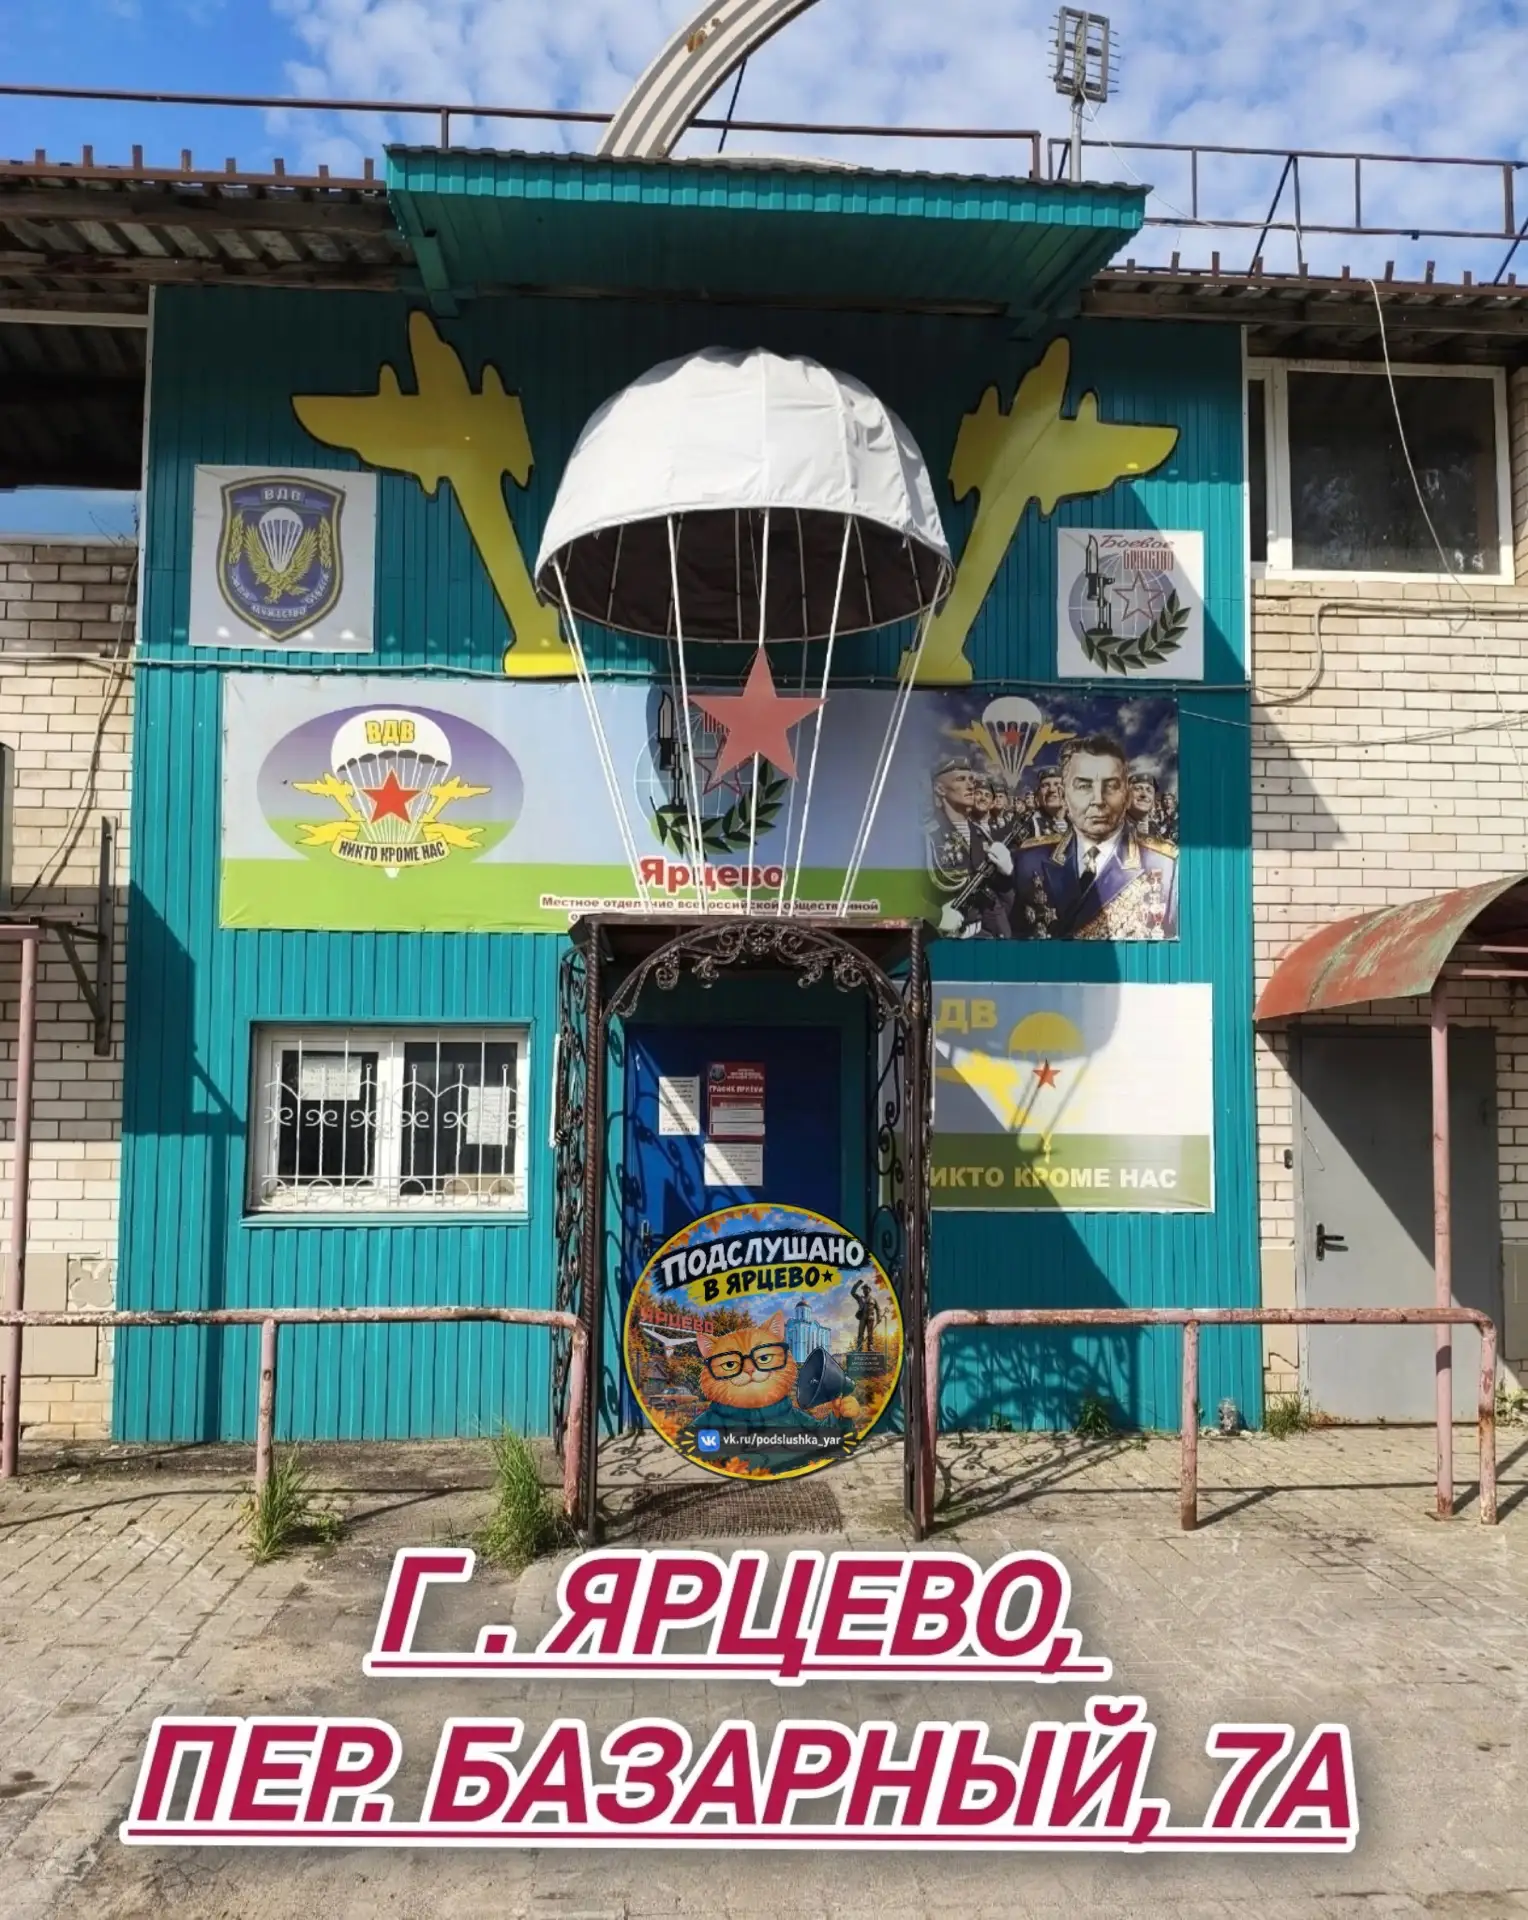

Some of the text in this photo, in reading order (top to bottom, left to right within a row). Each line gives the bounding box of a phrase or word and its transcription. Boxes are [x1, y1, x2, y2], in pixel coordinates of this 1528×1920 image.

[264, 488, 301, 501] ВДВ
[365, 720, 415, 746] ВДВ
[339, 840, 446, 862] НИКТО КРОМЕ НАС
[640, 858, 783, 893] Ярцево
[542, 897, 600, 908] Местное
[1014, 1166, 1111, 1188] КРОМЕ
[1120, 1168, 1177, 1188] НАС
